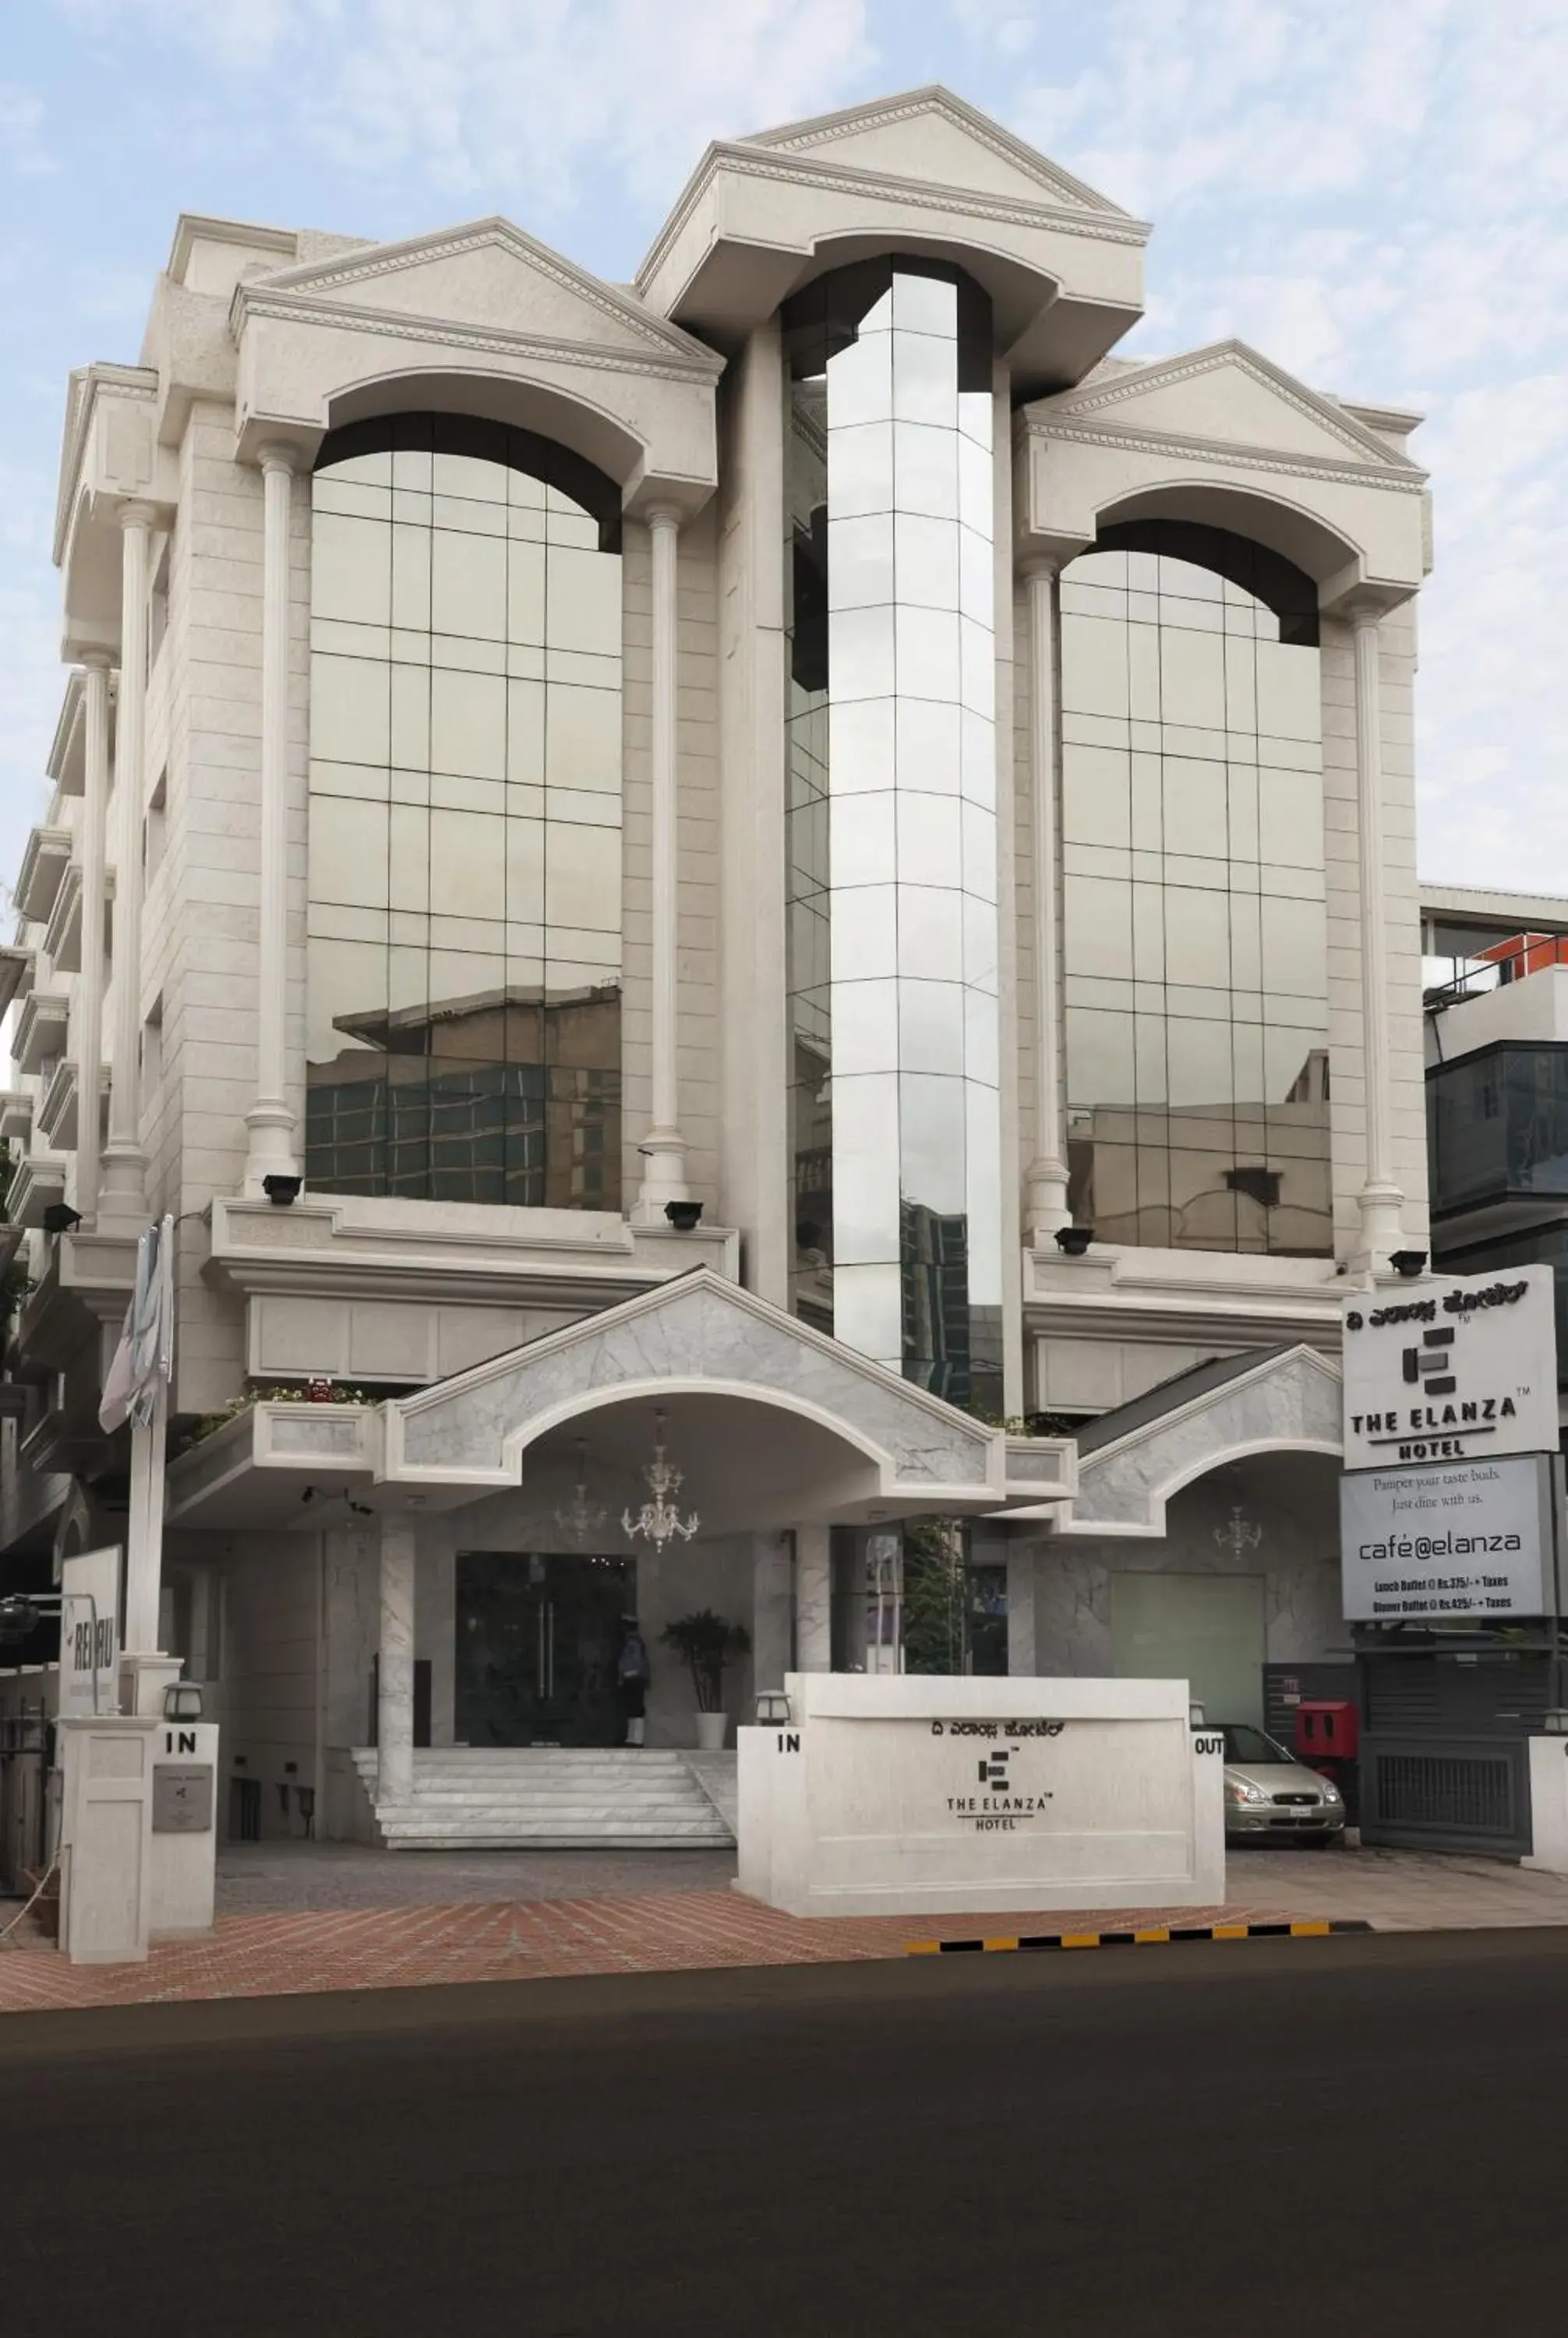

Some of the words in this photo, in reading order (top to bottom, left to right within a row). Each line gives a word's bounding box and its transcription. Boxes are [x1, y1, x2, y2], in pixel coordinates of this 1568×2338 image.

[1350, 1411, 1397, 1434] THE
[1410, 1397, 1516, 1429] ELANZA
[1517, 1386, 1531, 1396] TM
[1399, 1440, 1464, 1459] HOTEL
[1373, 1478, 1413, 1492] Pamper
[1417, 1476, 1441, 1490] your
[1443, 1472, 1468, 1484] taste
[1392, 1497, 1413, 1516] Just
[1414, 1495, 1438, 1509] dine
[1442, 1493, 1464, 1507] with
[1467, 1494, 1483, 1504] us.
[1359, 1529, 1520, 1559] café@elanza
[1482, 1575, 1509, 1588] Taxes
[1485, 1597, 1512, 1609] Taxes
[166, 1731, 196, 1754] IN
[778, 1734, 800, 1753] IN
[1195, 1738, 1224, 1754] OUT
[947, 1798, 976, 1810] THE
[983, 1798, 1046, 1810] ELANZA
[976, 1819, 1016, 1830] HOTEL
